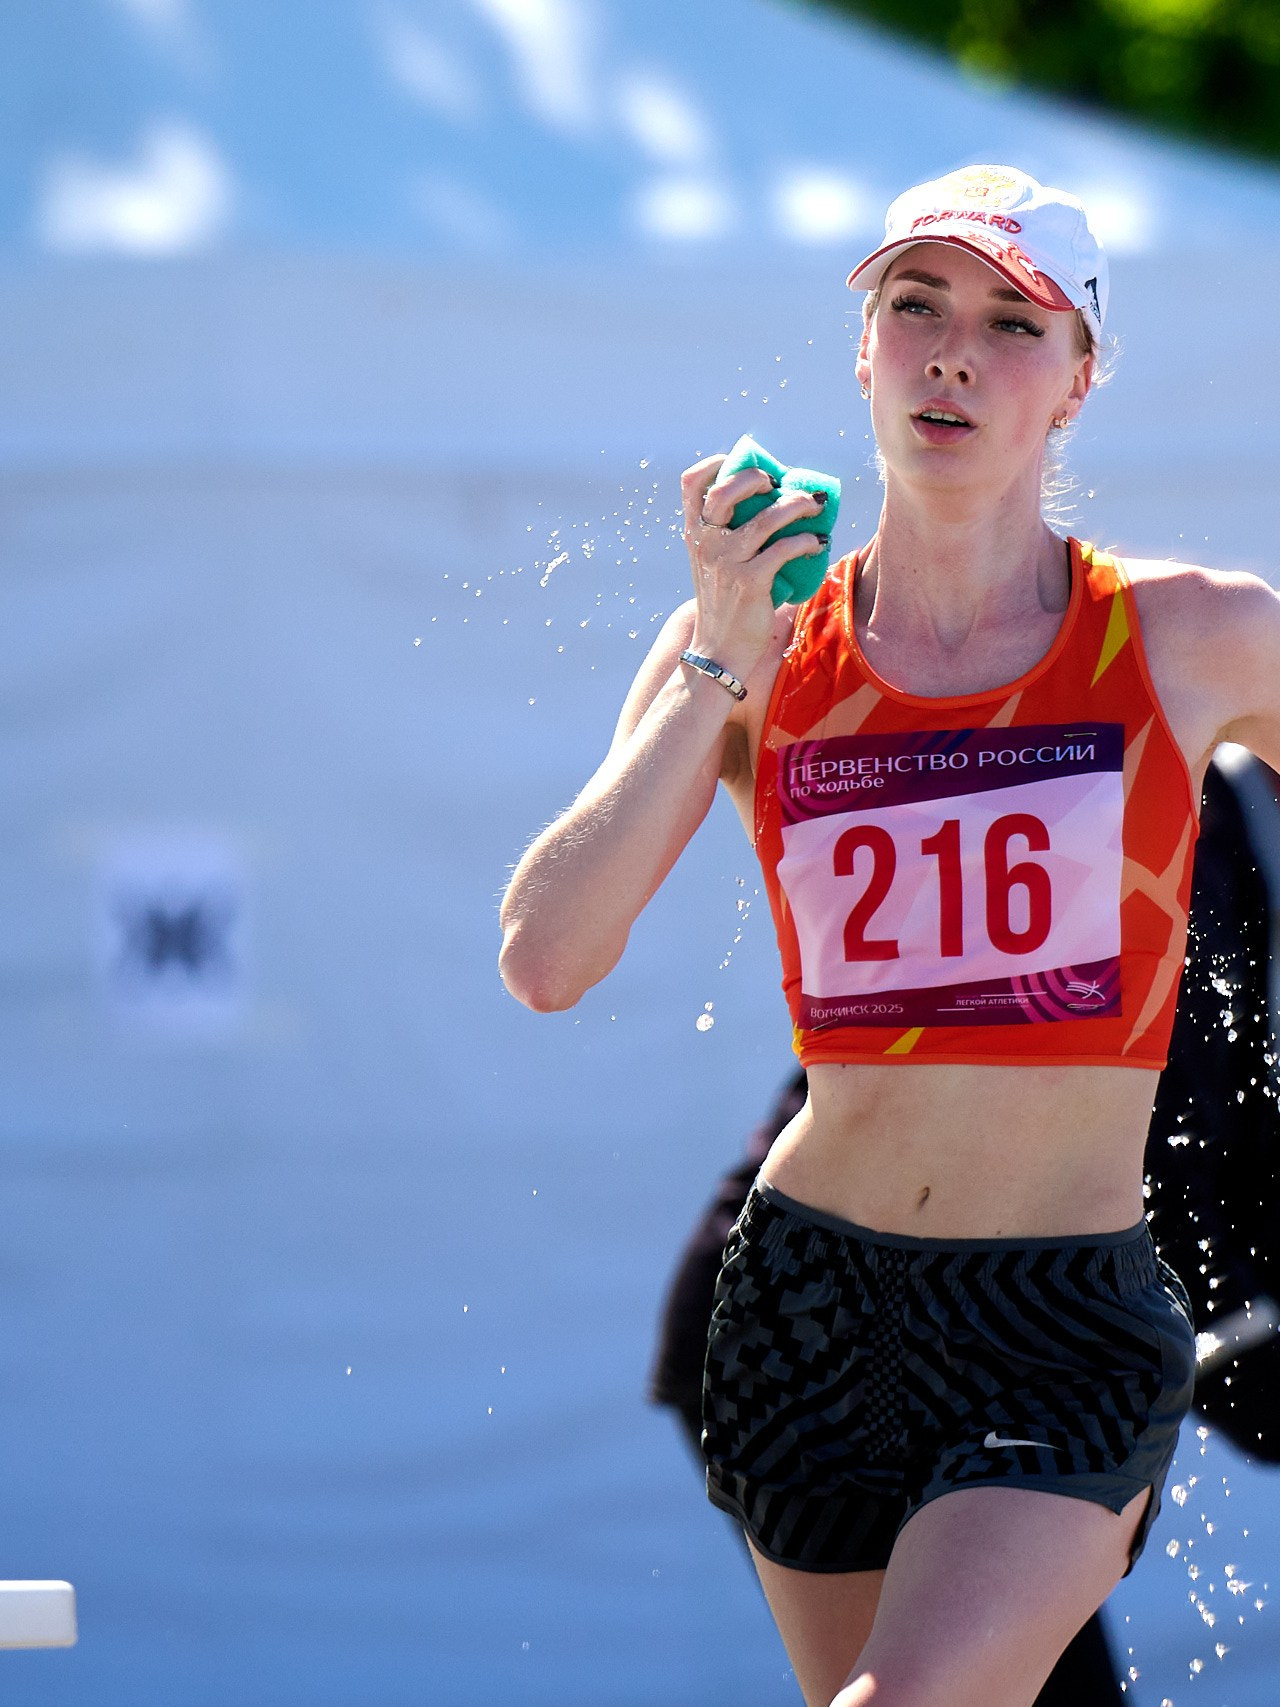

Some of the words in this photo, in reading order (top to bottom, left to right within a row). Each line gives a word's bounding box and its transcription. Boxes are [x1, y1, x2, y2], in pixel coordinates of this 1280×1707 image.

[910, 210, 1022, 234] FORWARD
[789, 752, 968, 784] ПЕРВЕНСТВО
[978, 744, 1095, 768] РОССИИ
[790, 785, 811, 799] по
[816, 775, 885, 794] ходьбе
[834, 813, 1051, 962] 216
[810, 1004, 869, 1019] ВОТКИНСК
[872, 1003, 904, 1014] 2025
[955, 997, 986, 1006] ЛЕГКОЙ
[988, 997, 1029, 1005] АТЛЕТИКИ
